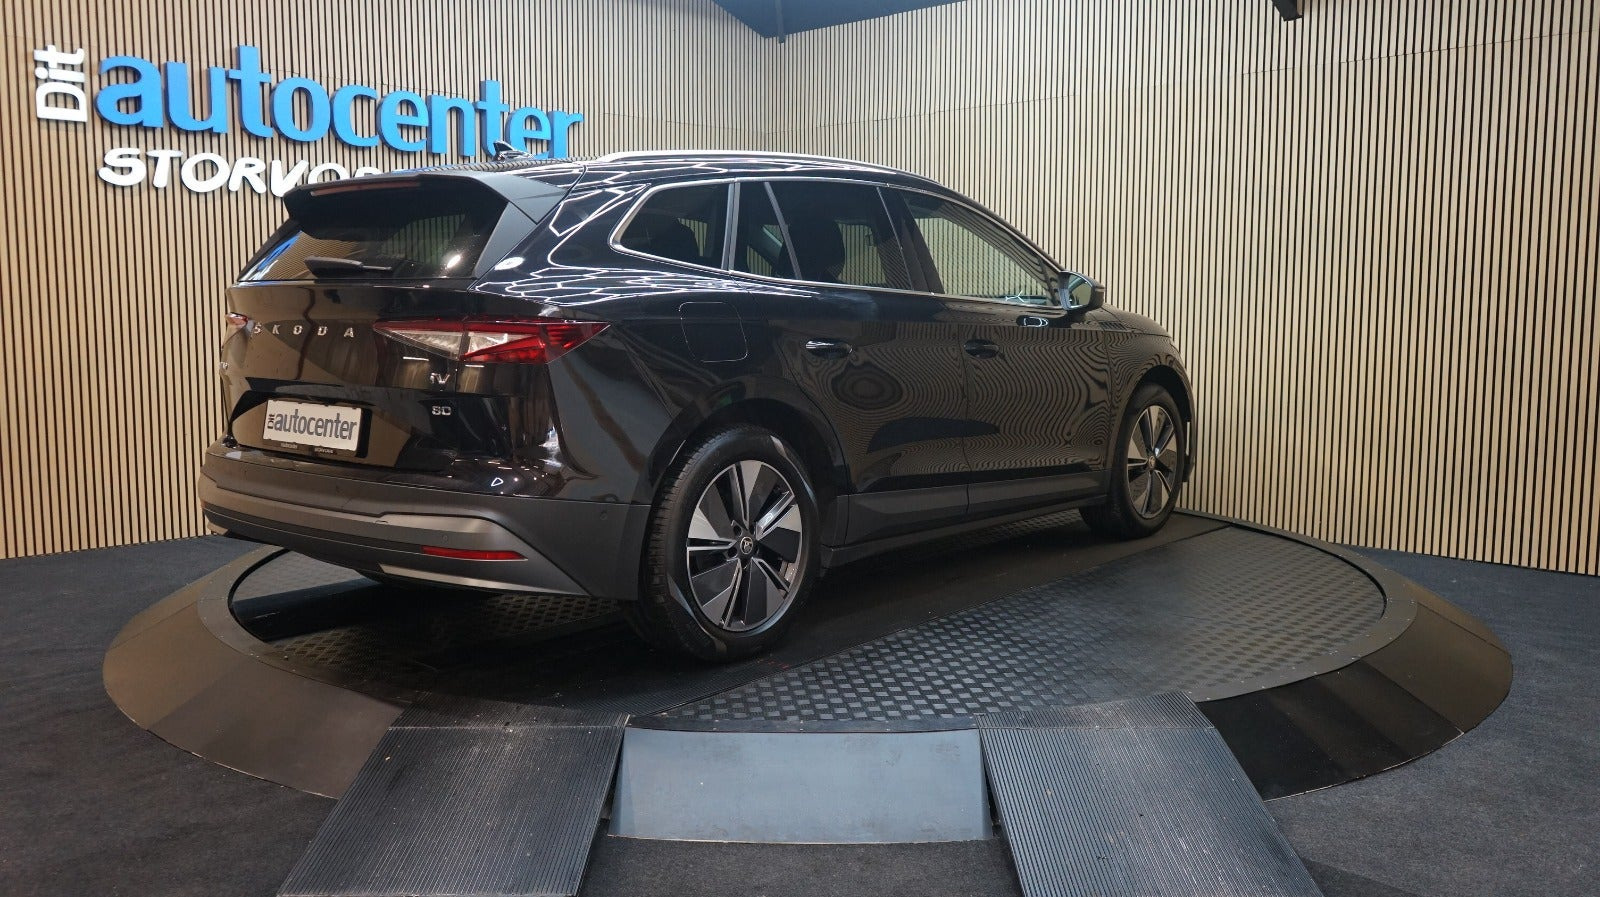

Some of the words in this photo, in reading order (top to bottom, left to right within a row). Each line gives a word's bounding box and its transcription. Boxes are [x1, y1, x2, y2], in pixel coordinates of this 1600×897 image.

[34, 44, 87, 123] Dit
[94, 46, 583, 159] autocenter
[267, 413, 276, 430] Dit
[274, 408, 357, 440] autocenter
